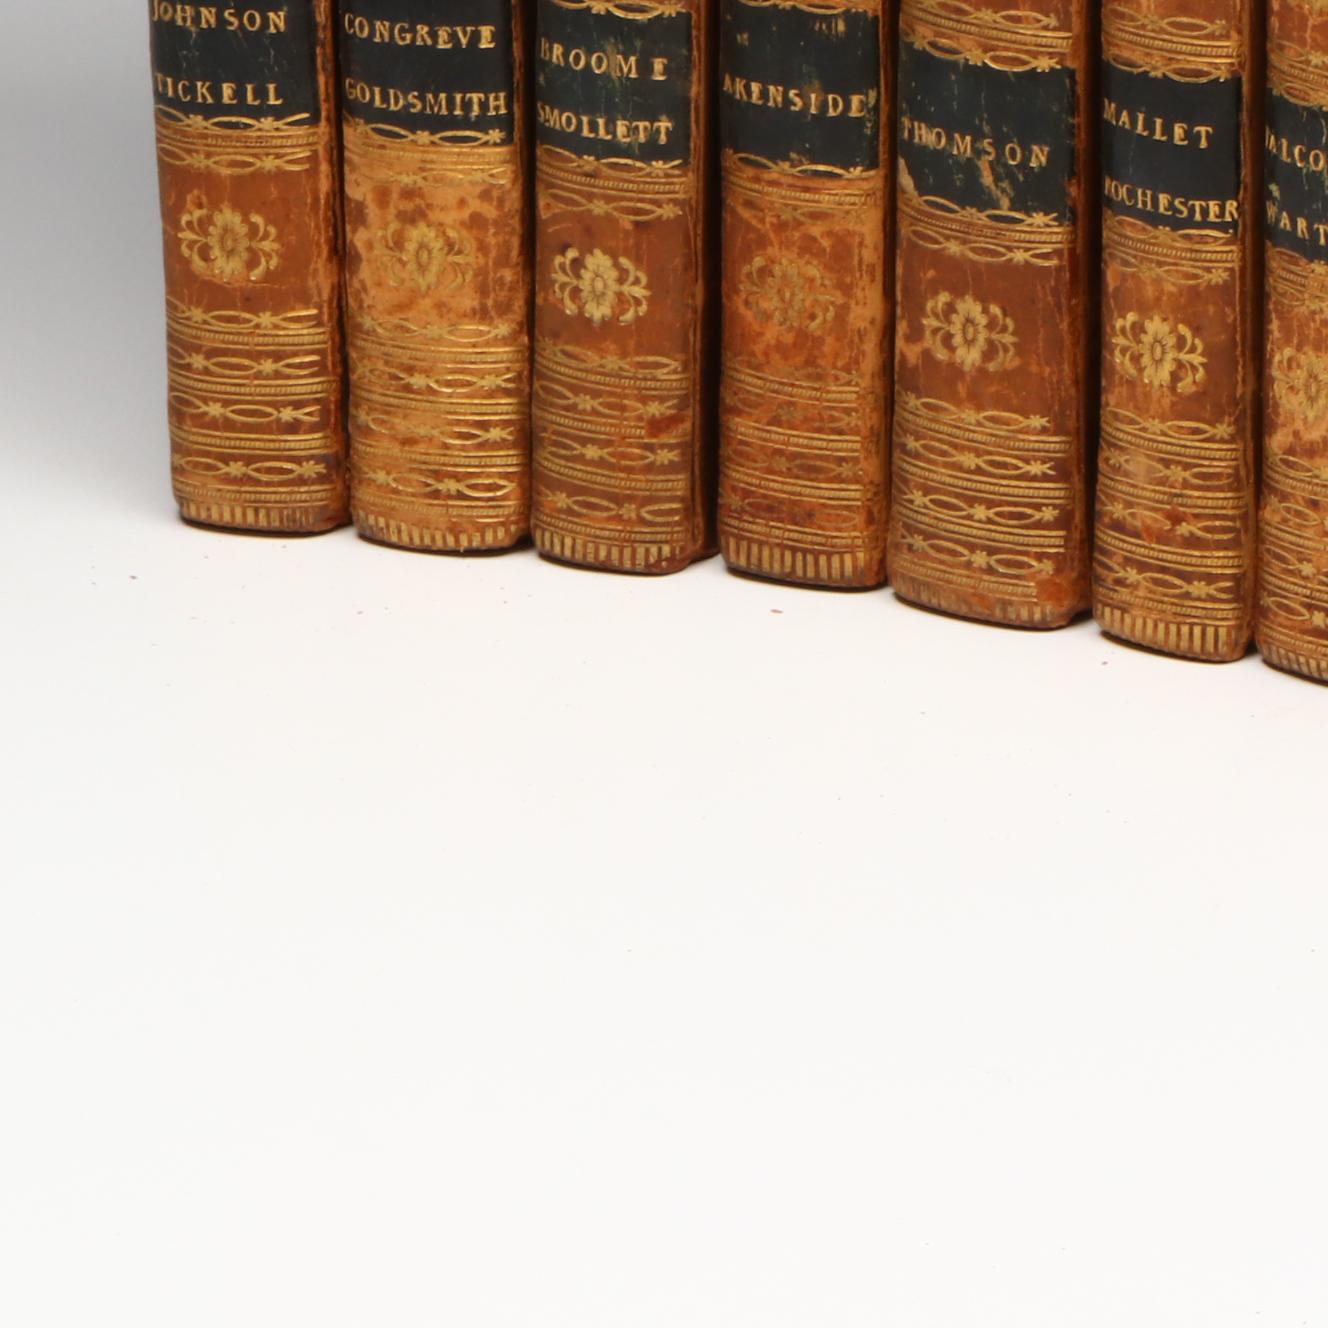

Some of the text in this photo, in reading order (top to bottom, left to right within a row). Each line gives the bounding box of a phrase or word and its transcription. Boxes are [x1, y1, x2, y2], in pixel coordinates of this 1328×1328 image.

[345, 12, 497, 50] CONGREVE
[540, 36, 669, 82] BROOME
[154, 72, 285, 106] TICKELL
[345, 76, 510, 118] GOLDSMITH
[722, 72, 868, 118] AKENSIDE
[536, 100, 674, 146] SMOLLETT
[901, 115, 1051, 170] THOMSON
[1103, 97, 1214, 150] MALLET
[1103, 175, 1241, 224] ROCHESTER
